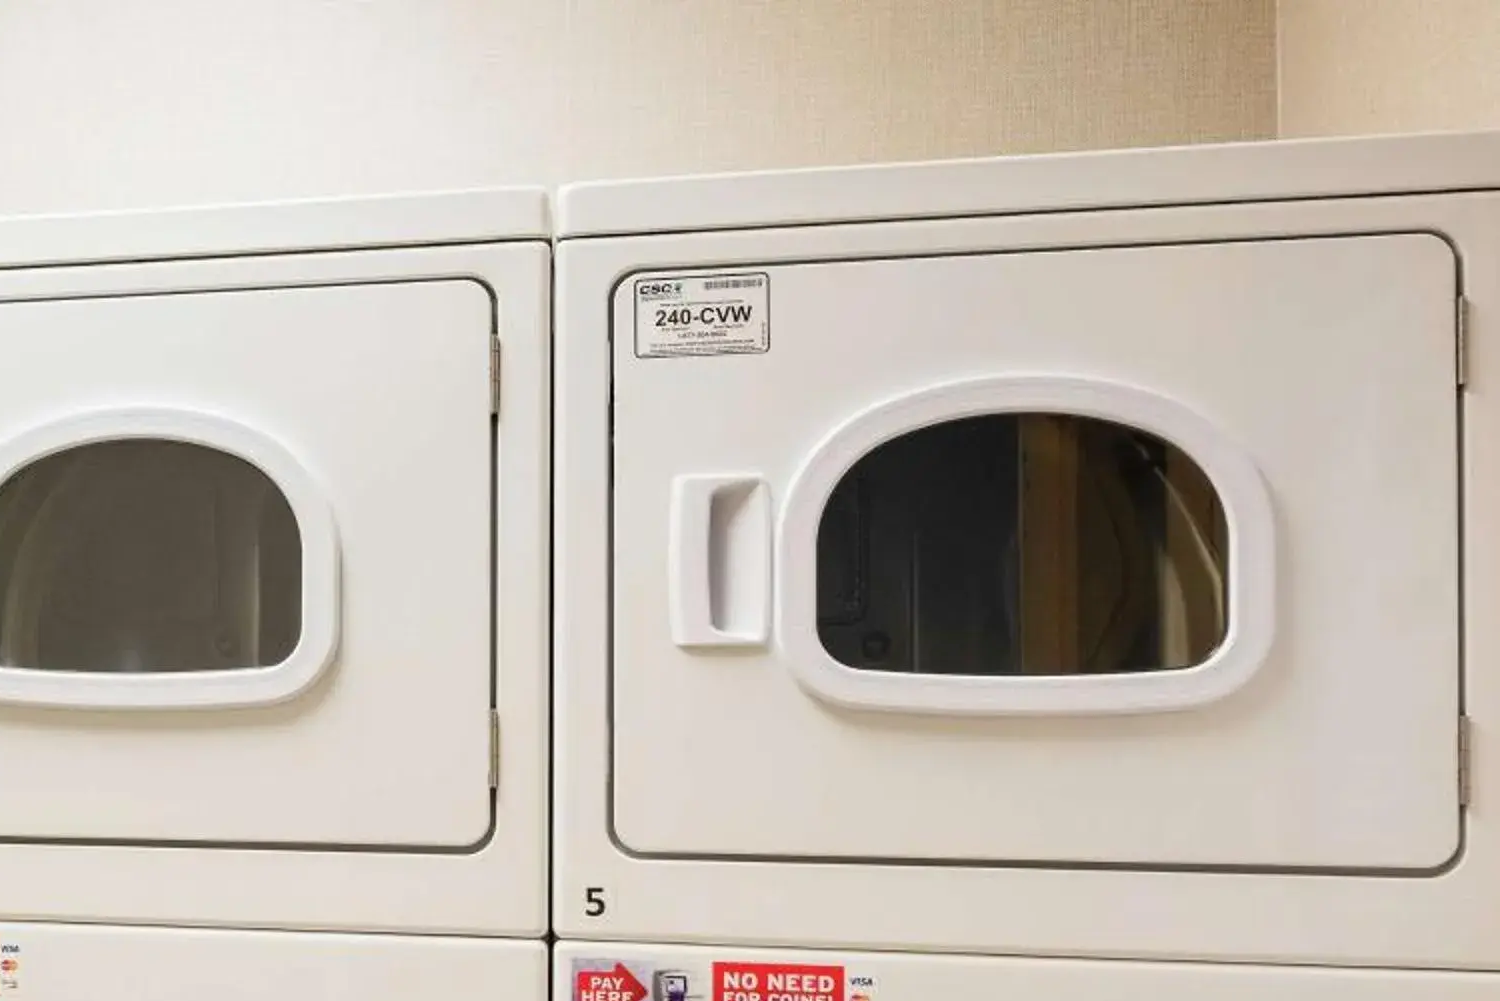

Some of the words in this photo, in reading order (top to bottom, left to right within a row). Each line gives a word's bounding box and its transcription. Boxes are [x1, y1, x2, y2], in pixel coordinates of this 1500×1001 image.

[655, 305, 752, 327] 240-CVW
[585, 887, 606, 917] 5
[590, 976, 624, 992] PAY
[723, 971, 758, 990] NO
[767, 973, 835, 994] NEED
[850, 977, 873, 987] VISA
